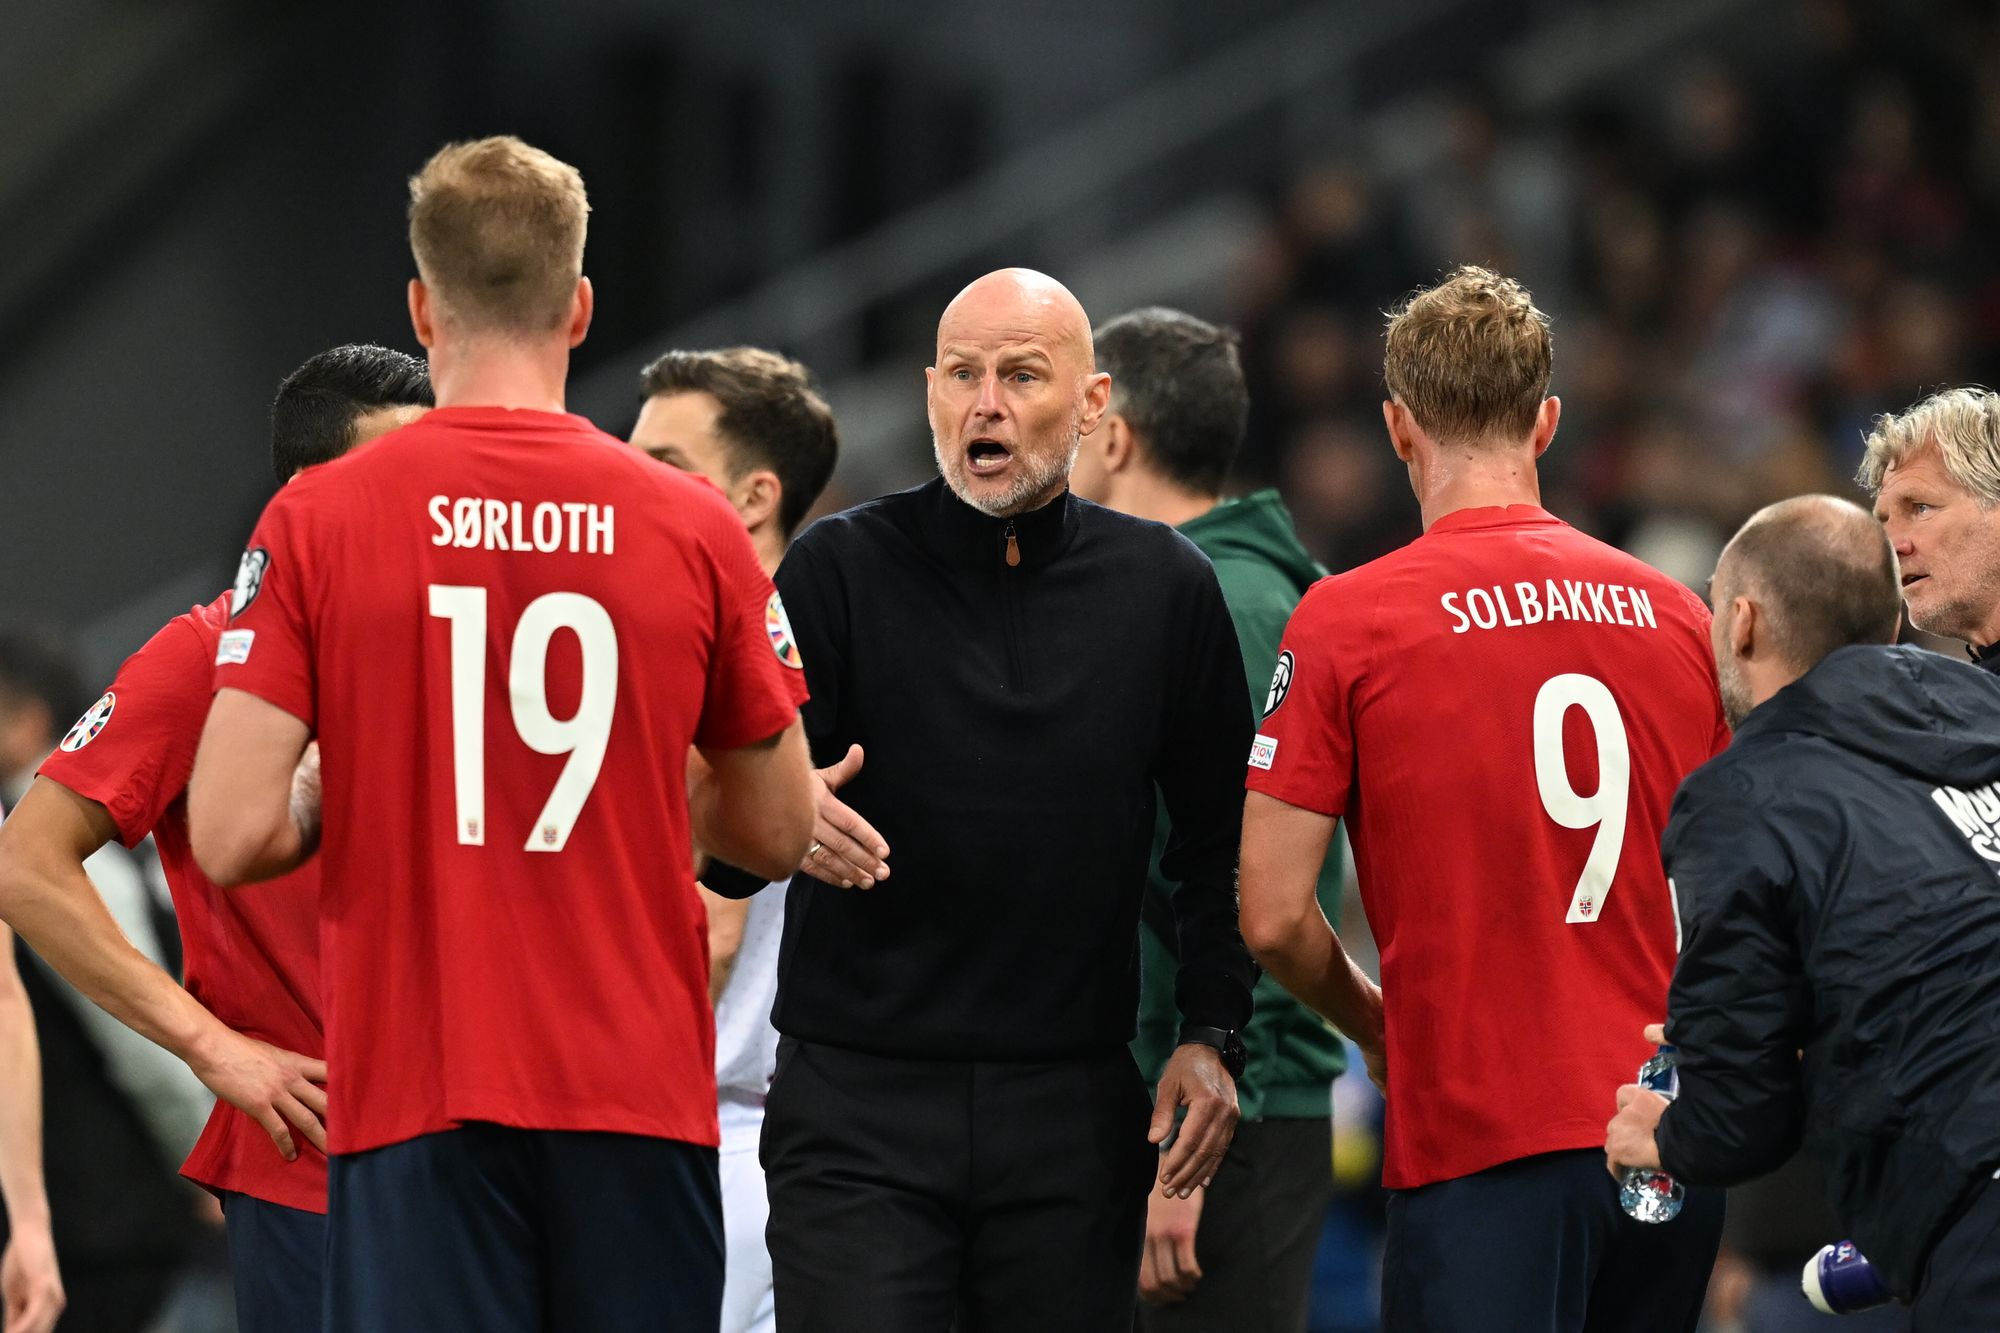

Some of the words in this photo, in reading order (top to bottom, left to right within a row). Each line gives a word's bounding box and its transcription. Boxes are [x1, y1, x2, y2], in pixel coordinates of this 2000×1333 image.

[428, 494, 615, 555] SØRLOTH
[1441, 579, 1657, 634] SOLBAKKEN
[428, 584, 619, 853] 19
[1533, 673, 1631, 924] 9
